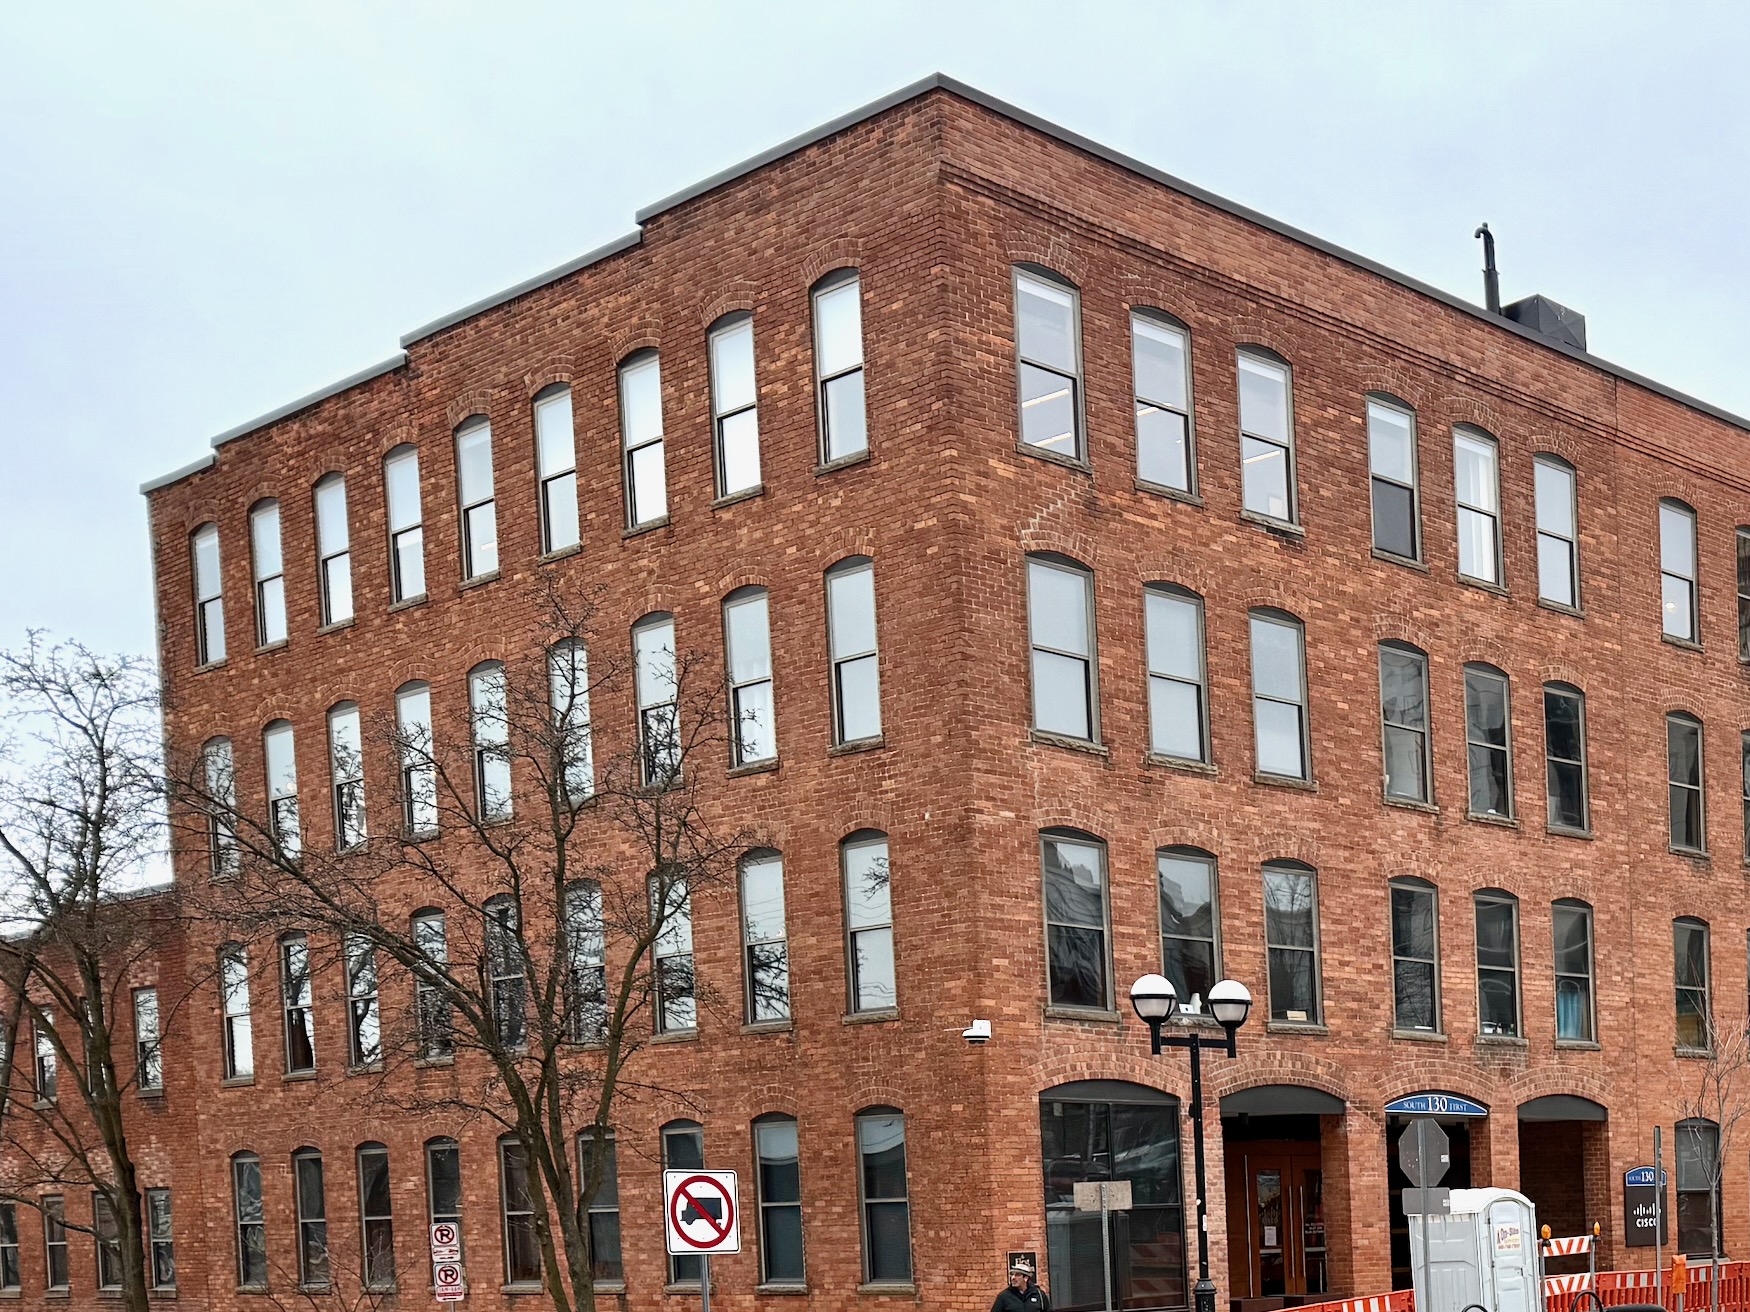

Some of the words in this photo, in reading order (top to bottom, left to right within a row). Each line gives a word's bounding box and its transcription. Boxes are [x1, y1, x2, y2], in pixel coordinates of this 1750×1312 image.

[1403, 1101, 1427, 1110] SOUTH
[1428, 1097, 1448, 1112] 130
[1449, 1103, 1468, 1111] FIRST
[1641, 1170, 1655, 1183] 130
